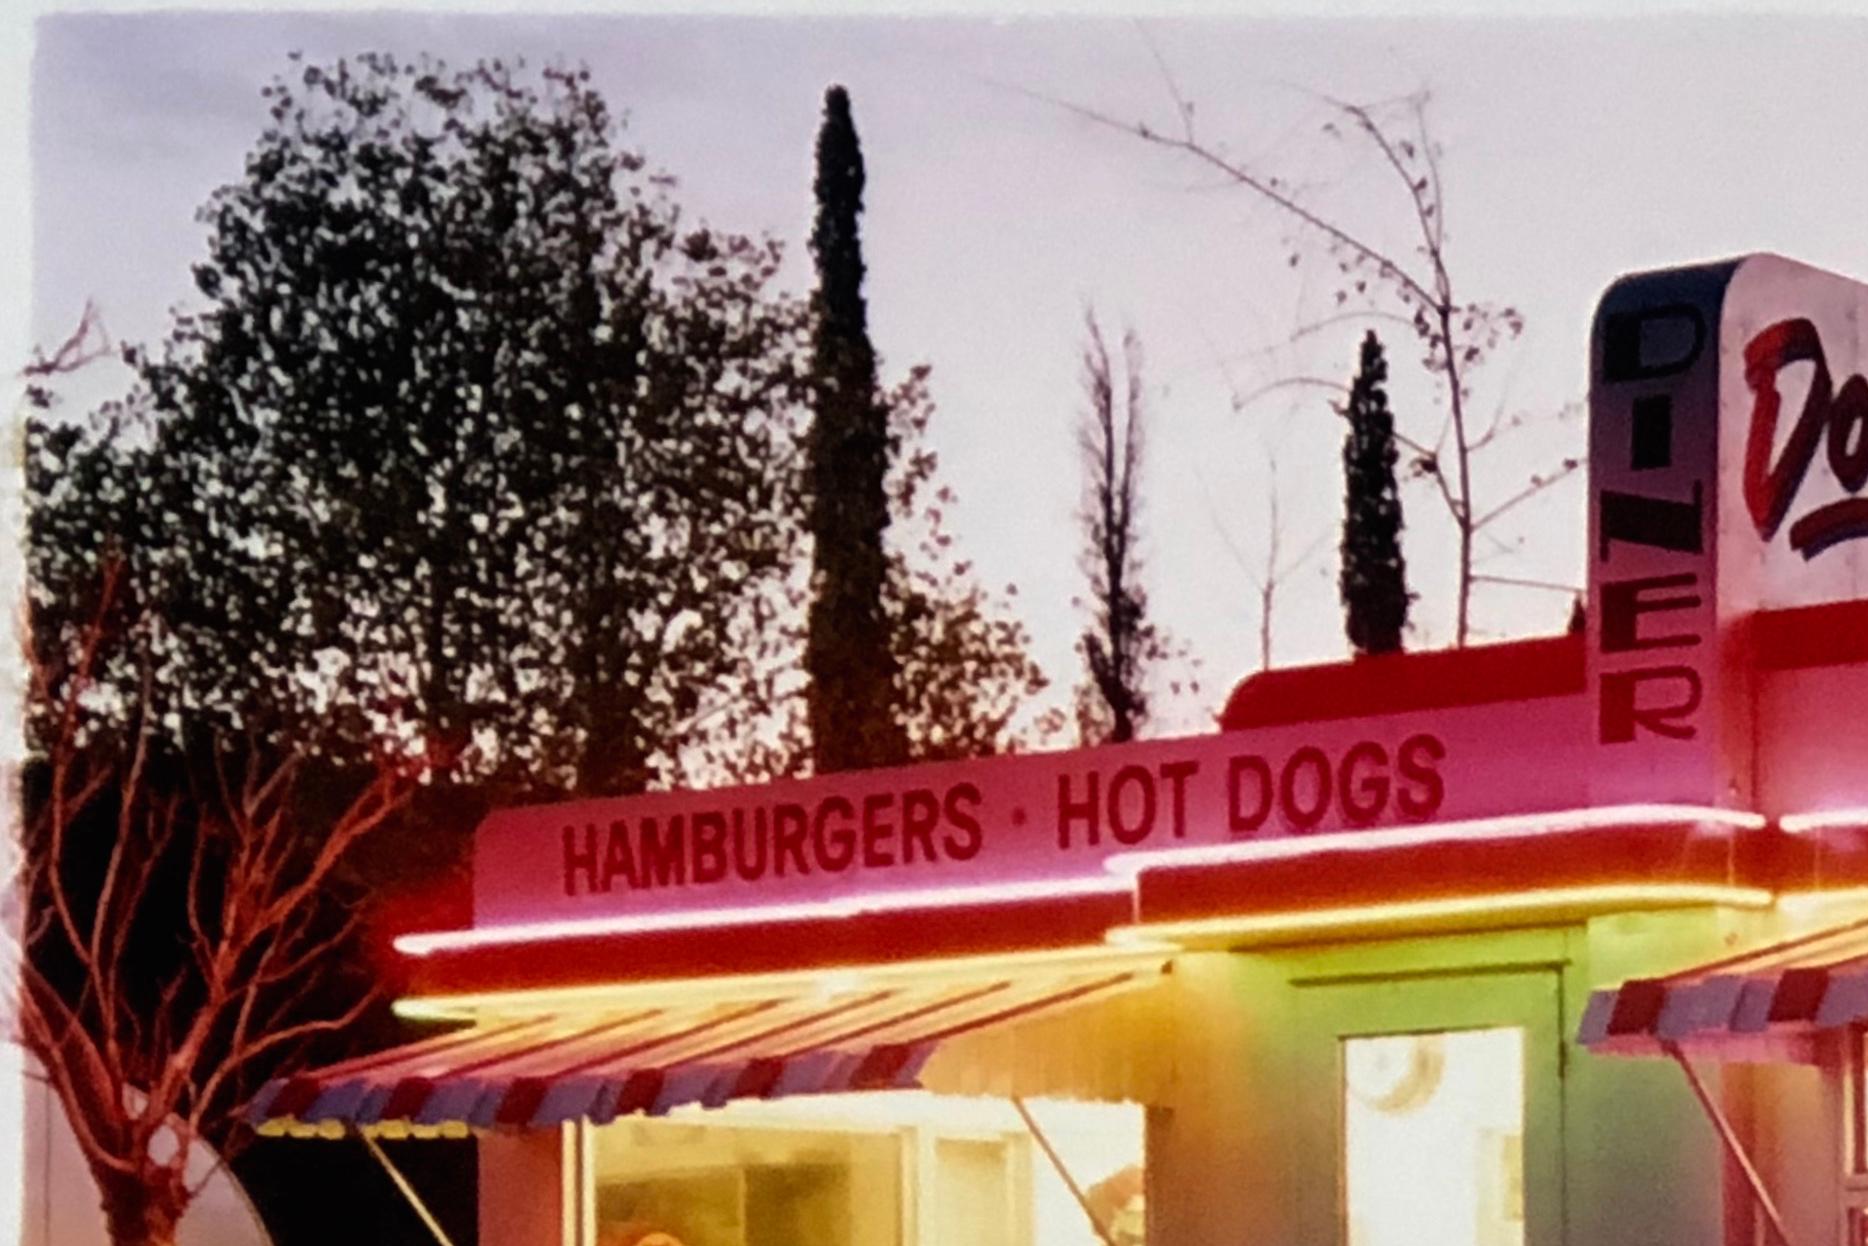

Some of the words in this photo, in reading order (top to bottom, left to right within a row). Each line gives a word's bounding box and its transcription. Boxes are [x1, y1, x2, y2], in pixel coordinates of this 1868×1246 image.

[1600, 304, 1705, 745] DINER
[561, 780, 984, 897] HAMBURGERS
[1056, 760, 1200, 851] HOT
[1226, 732, 1448, 834] DOGS
